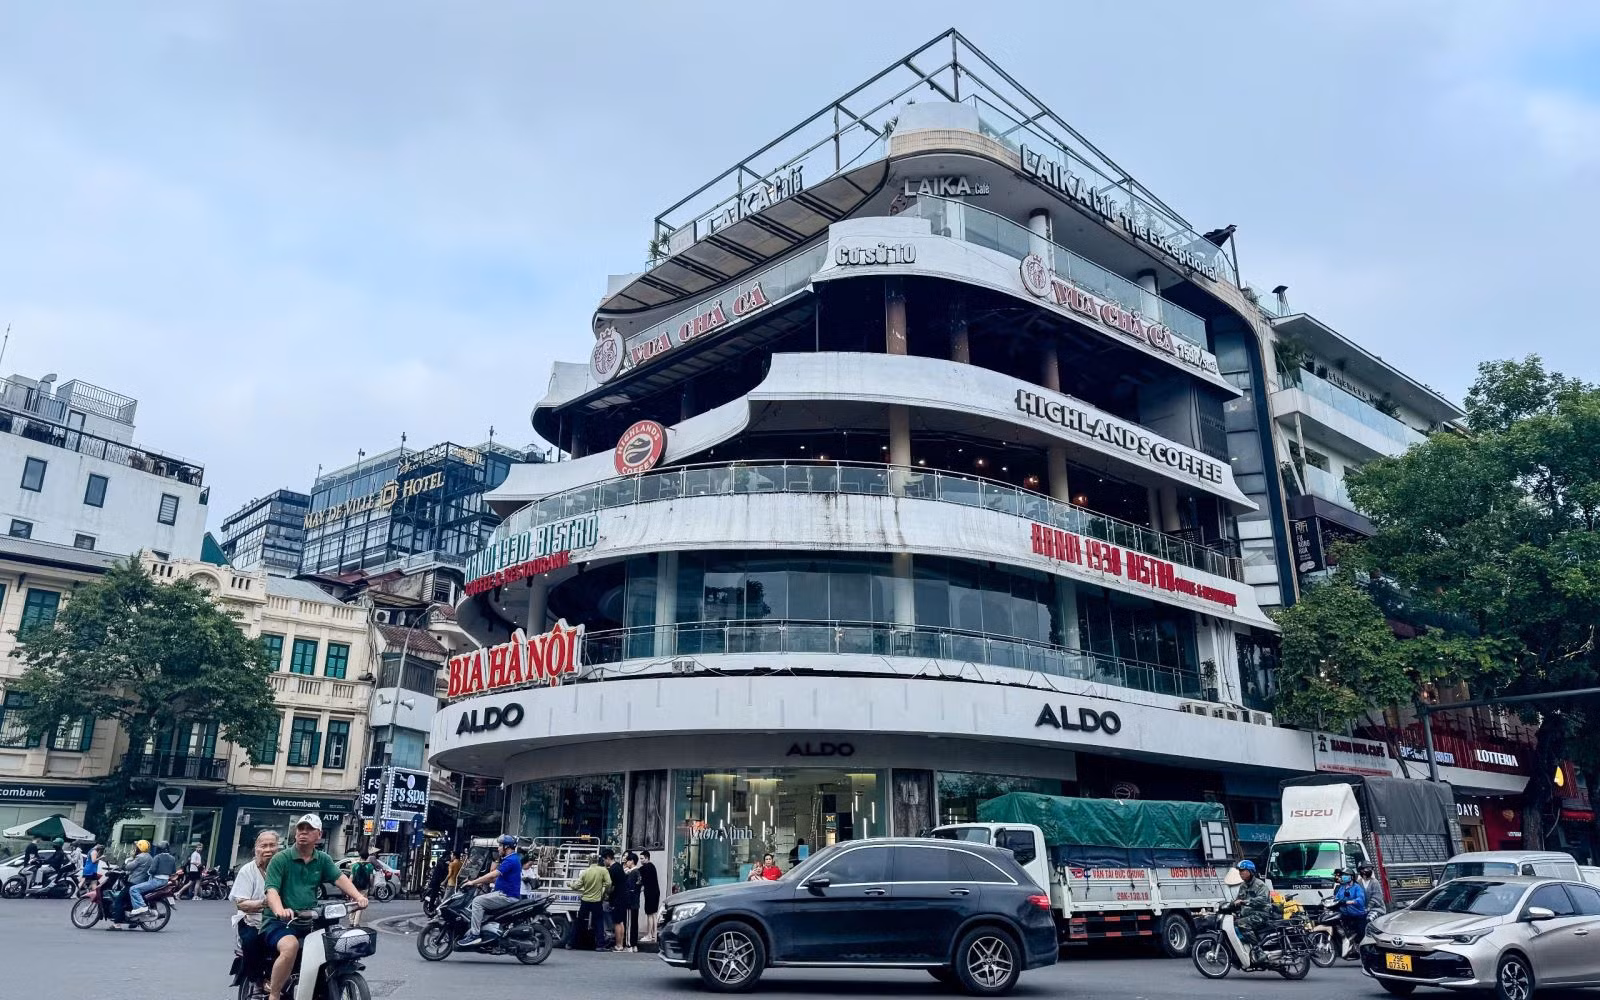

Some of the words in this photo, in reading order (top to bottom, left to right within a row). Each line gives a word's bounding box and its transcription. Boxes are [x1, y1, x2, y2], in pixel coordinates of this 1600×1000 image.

[706, 185, 774, 235] LAIKA
[773, 165, 804, 203] Café
[904, 175, 972, 196] LAIKA
[1020, 143, 1090, 207] LAIKA
[1119, 211, 1148, 239] The
[1149, 229, 1218, 282] Exceptional
[835, 245, 861, 265] Cơ
[864, 242, 889, 265] sở
[892, 243, 917, 264] 10
[631, 331, 672, 365] VUA
[678, 300, 728, 343] CHẢ
[732, 281, 768, 317] CÁ
[1051, 281, 1101, 322] VUA
[1100, 301, 1148, 342] CHẢ
[1147, 323, 1177, 355] CÁ
[617, 424, 660, 454] HIGHLANDS
[1015, 388, 1151, 455] HIGHLANDS
[1151, 442, 1222, 484] COFFEE
[621, 456, 656, 474] COFFEE
[303, 508, 330, 528] MAY
[328, 504, 347, 522] DE
[344, 494, 375, 517] VILLE
[402, 471, 445, 497] HOTEL
[465, 543, 498, 585] HANOI
[499, 531, 532, 568] 1930
[535, 515, 599, 556] BISTRO
[1030, 523, 1083, 565] HANOI
[1084, 538, 1122, 576] 1930
[464, 575, 496, 597] COFFEE
[503, 550, 570, 584] RESTAURANT
[447, 652, 485, 698] BIA
[487, 631, 523, 689] HÀ
[525, 622, 578, 688] NỘI
[455, 702, 525, 735] ALDO
[1034, 703, 1122, 735] ALDO
[785, 742, 856, 757] ALDO
[1476, 749, 1519, 767] LOTTERIA
[368, 779, 381, 790] FS
[393, 787, 406, 802] FS
[407, 788, 426, 805] SPA
[272, 798, 320, 808] Vietcombank
[1290, 809, 1333, 818] ISUZU
[1457, 803, 1480, 816] DAYS
[722, 825, 753, 840] Minh
